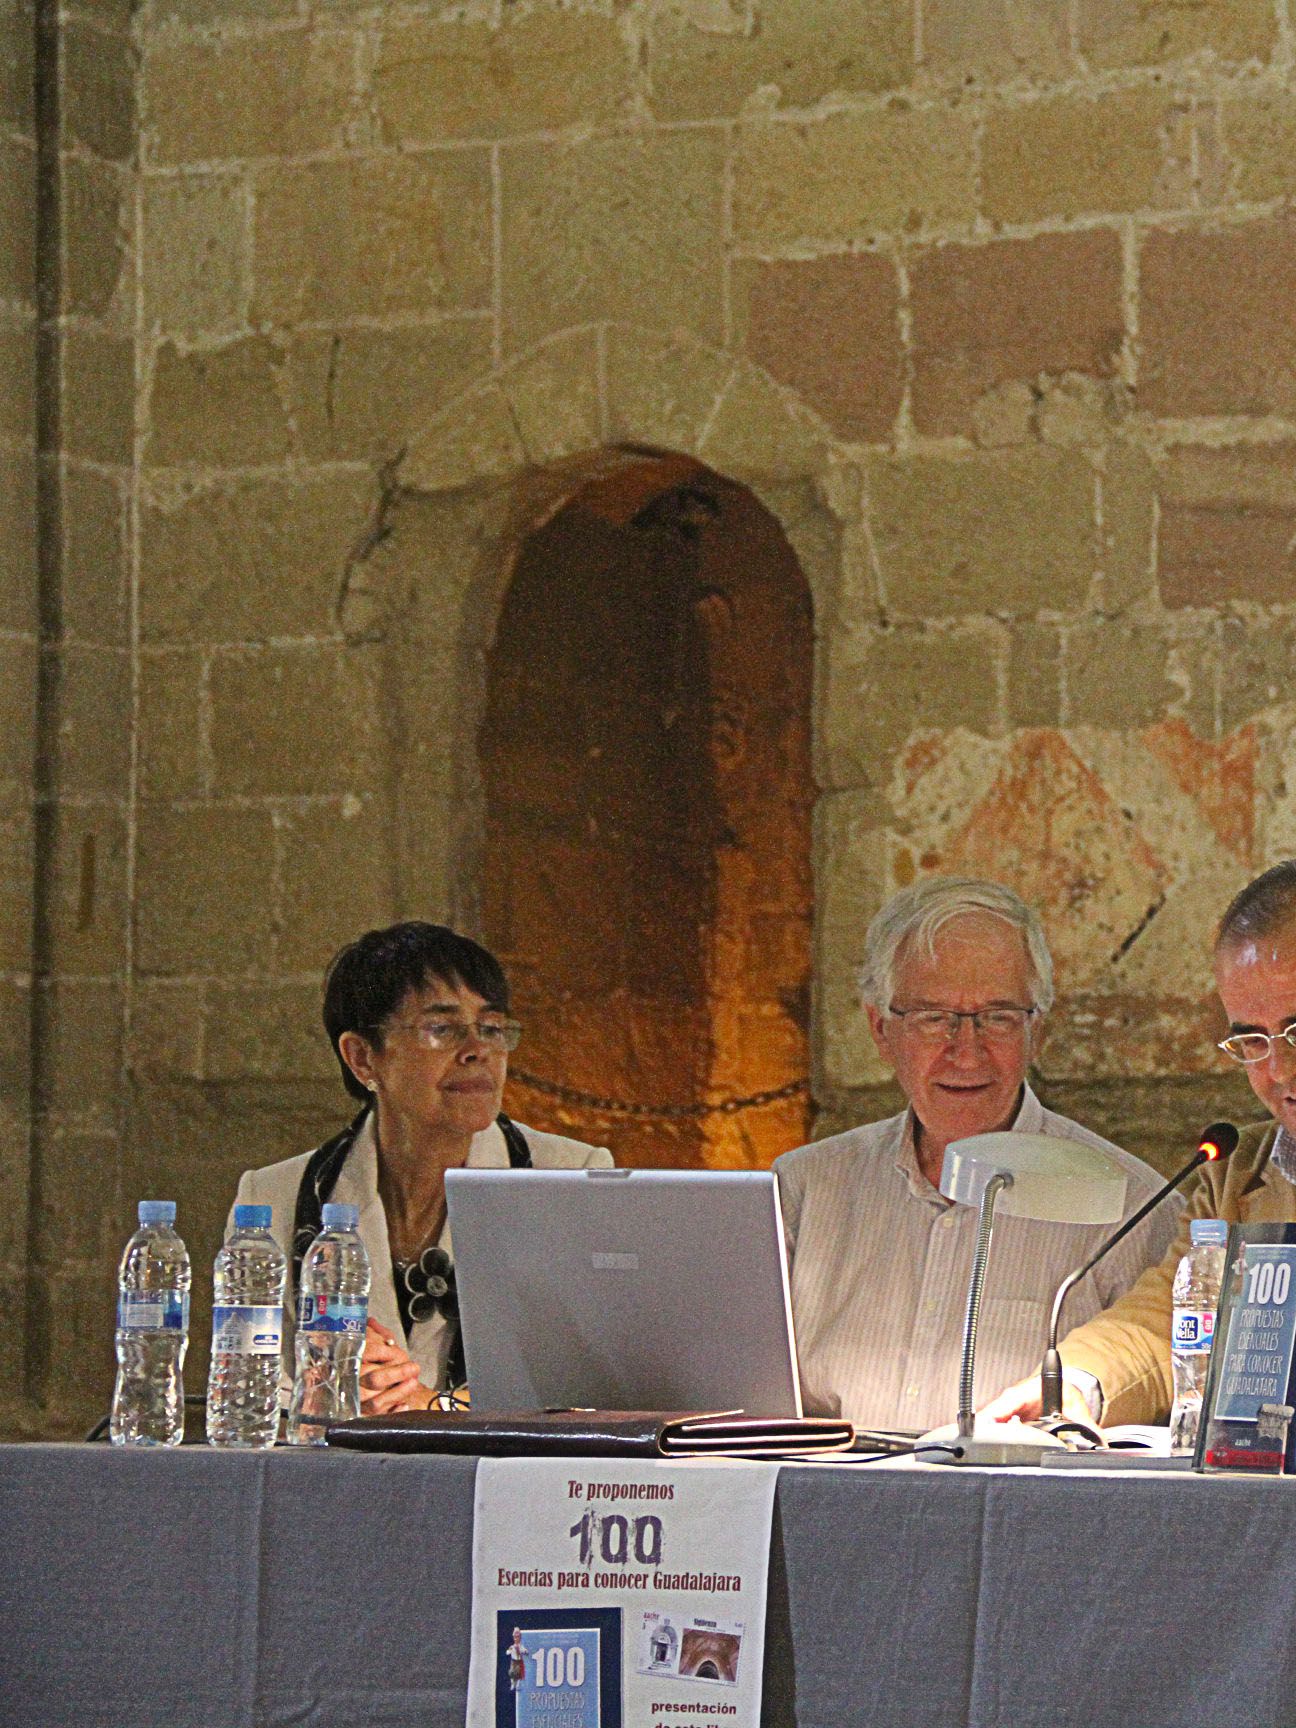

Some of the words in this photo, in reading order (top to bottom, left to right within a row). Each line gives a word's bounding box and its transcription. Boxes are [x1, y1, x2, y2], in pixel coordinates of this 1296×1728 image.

[1248, 1262, 1291, 1305] 100
[1240, 1309, 1285, 1329] PROPUESTAS
[1238, 1332, 1280, 1351] ESENCIALES
[1228, 1353, 1247, 1373] PARA
[1247, 1354, 1284, 1375] CONOCER
[568, 1480, 583, 1498] Te
[587, 1482, 675, 1501] proponemos
[569, 1509, 663, 1566] 100
[497, 1568, 553, 1587] Esencias
[557, 1571, 590, 1590] para
[593, 1571, 649, 1590] conocer
[653, 1571, 742, 1593] Guadalajara
[532, 1646, 585, 1687] 100
[651, 1702, 737, 1715] presentación
